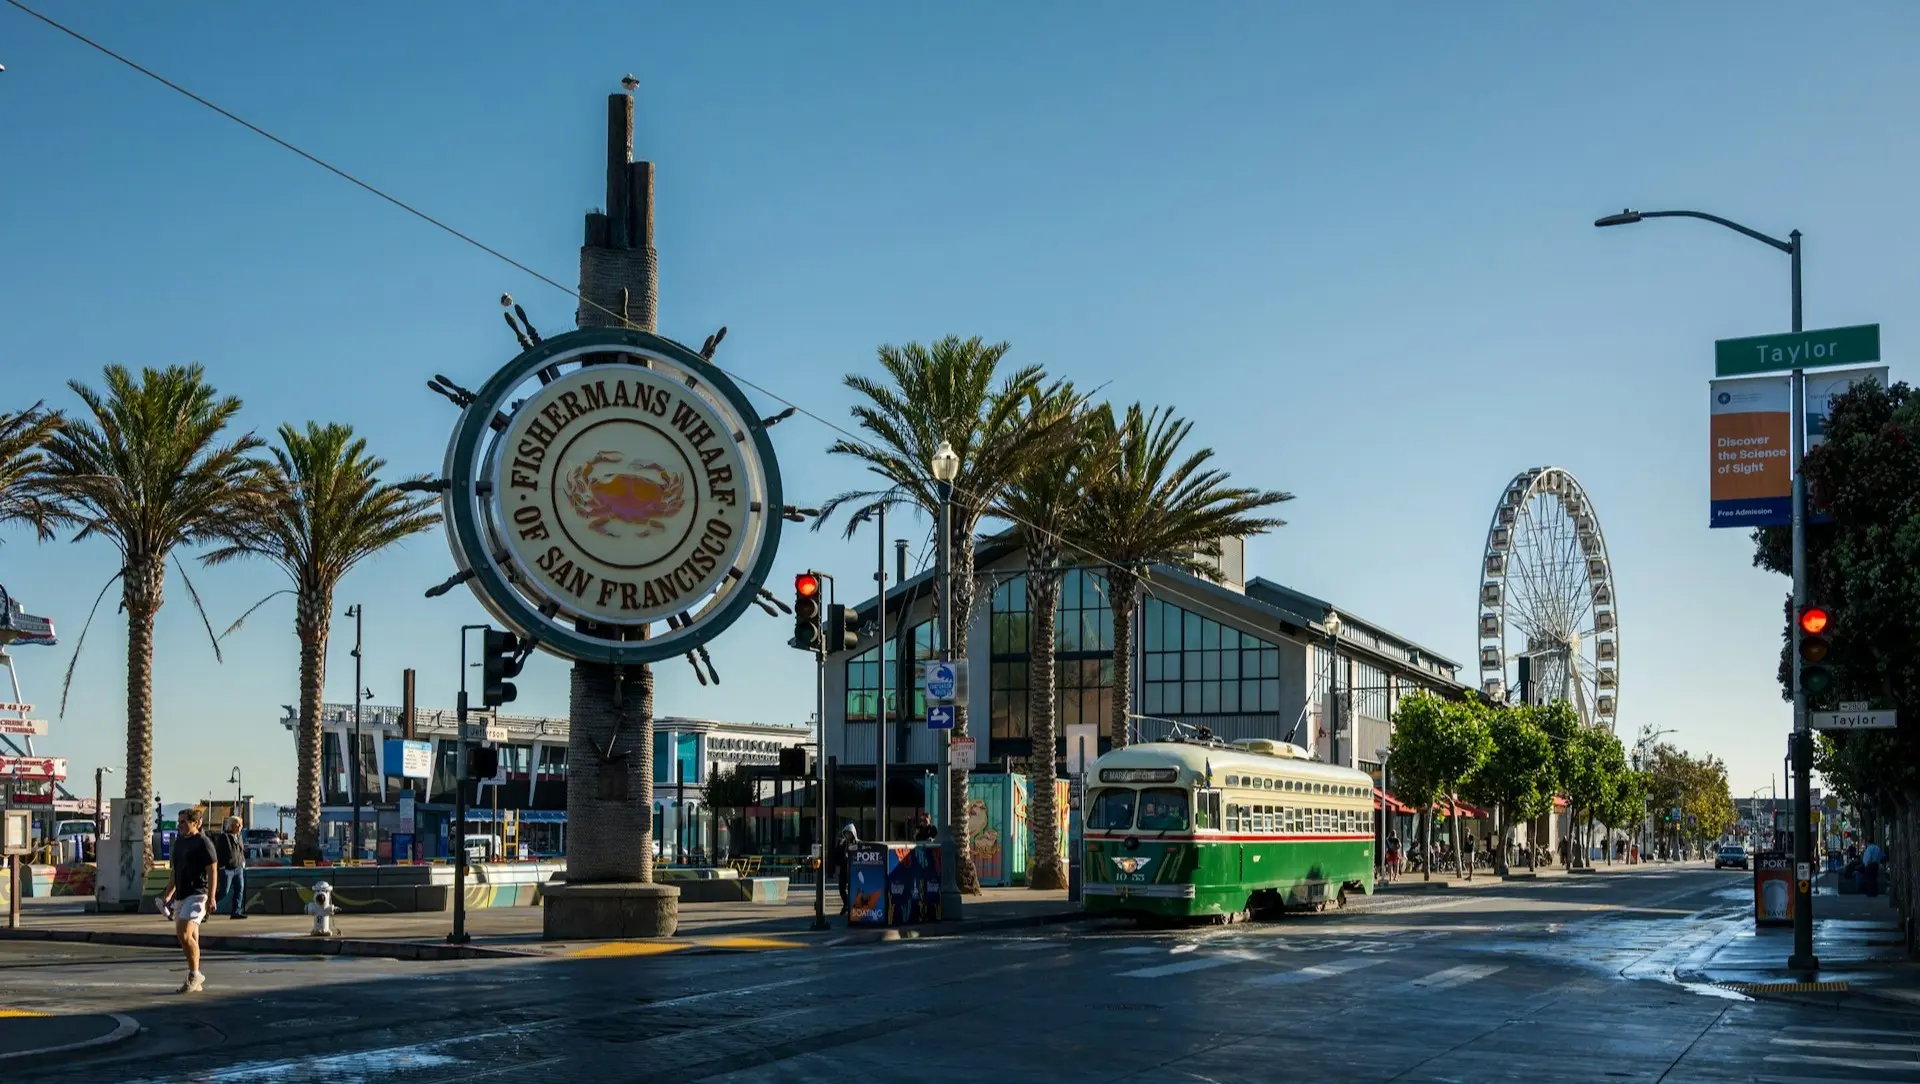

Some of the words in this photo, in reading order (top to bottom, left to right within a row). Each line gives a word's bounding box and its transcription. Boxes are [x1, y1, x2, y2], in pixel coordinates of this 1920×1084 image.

[1756, 340, 1838, 364] Taylor
[510, 379, 671, 492] FISHERMANS
[671, 399, 736, 507] WHARF
[1717, 436, 1770, 447] Discover
[1717, 451, 1737, 460] the
[1739, 449, 1787, 459] Science
[1717, 464, 1731, 474] of
[1732, 462, 1765, 475] Sight
[1717, 509, 1734, 517] Free
[1735, 508, 1773, 516] Admission
[513, 505, 550, 541] OF
[536, 546, 595, 598] SAN
[596, 518, 733, 611] FRANCISCO
[20, 704, 31, 712] 1/2
[1832, 715, 1876, 727] Taylor
[470, 727, 504, 738] Jefferson
[856, 851, 880, 861] PORT
[1763, 859, 1788, 868] PORT
[852, 908, 883, 918] BOATING
